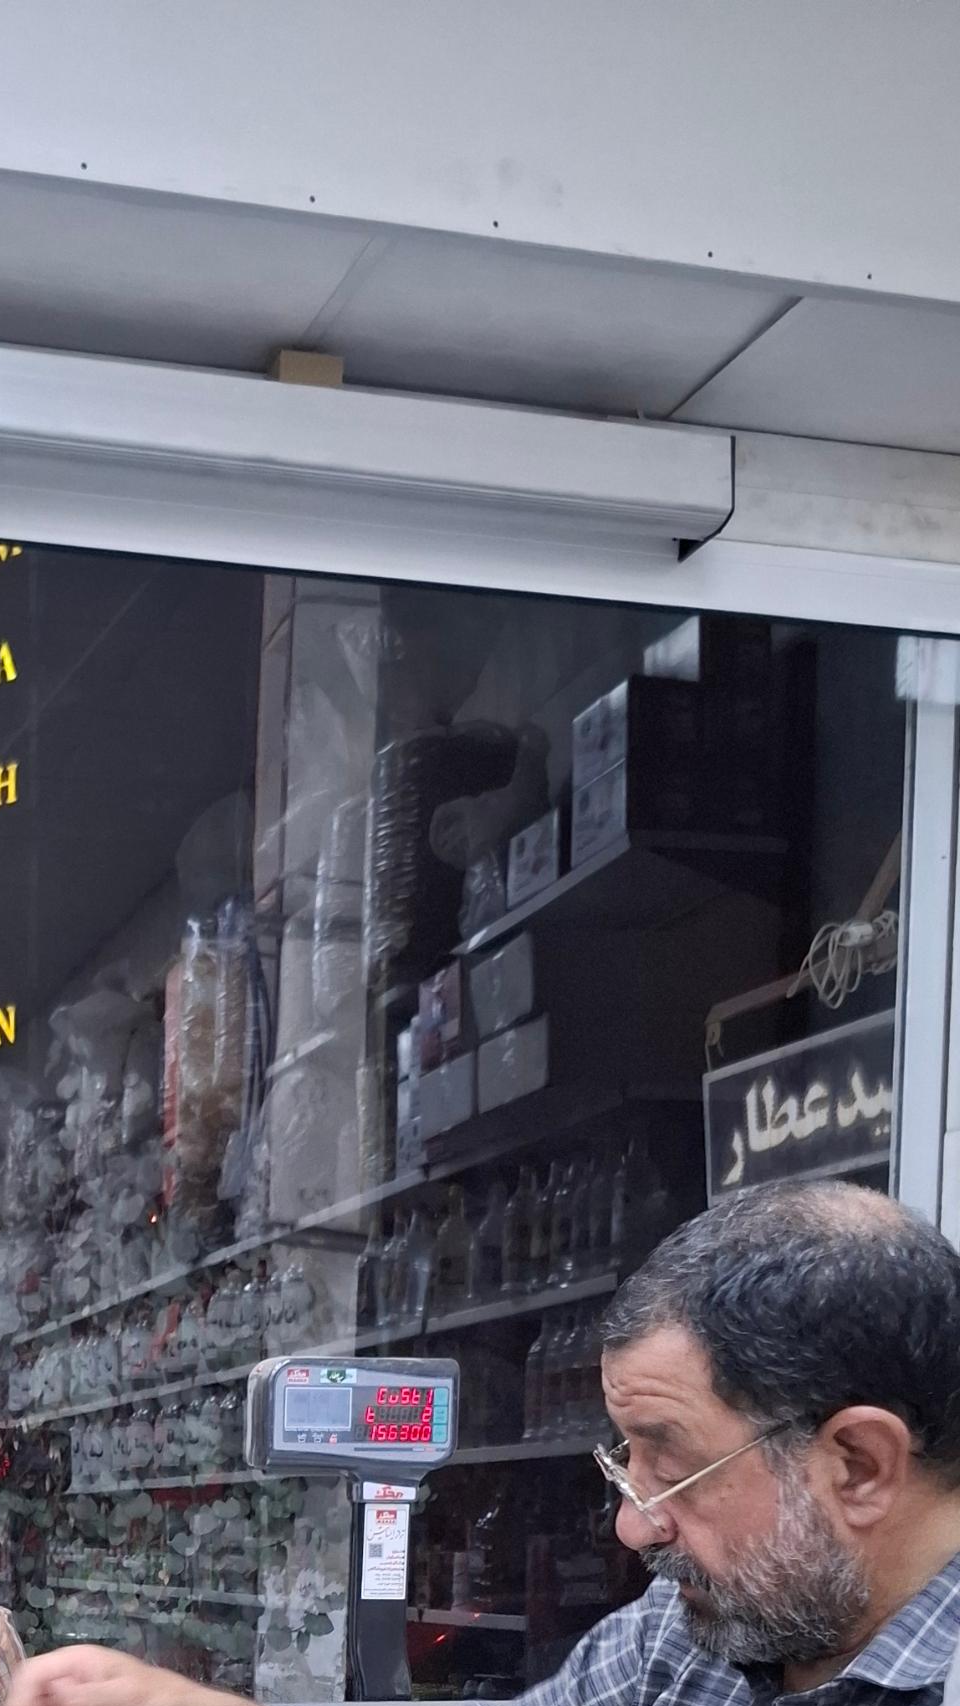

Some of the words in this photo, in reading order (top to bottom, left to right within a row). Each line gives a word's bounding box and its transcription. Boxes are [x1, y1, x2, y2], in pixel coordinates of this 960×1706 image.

[722, 1074, 829, 1186] عطار
[421, 1405, 432, 1422] 2
[370, 1425, 431, 1441] 156300
